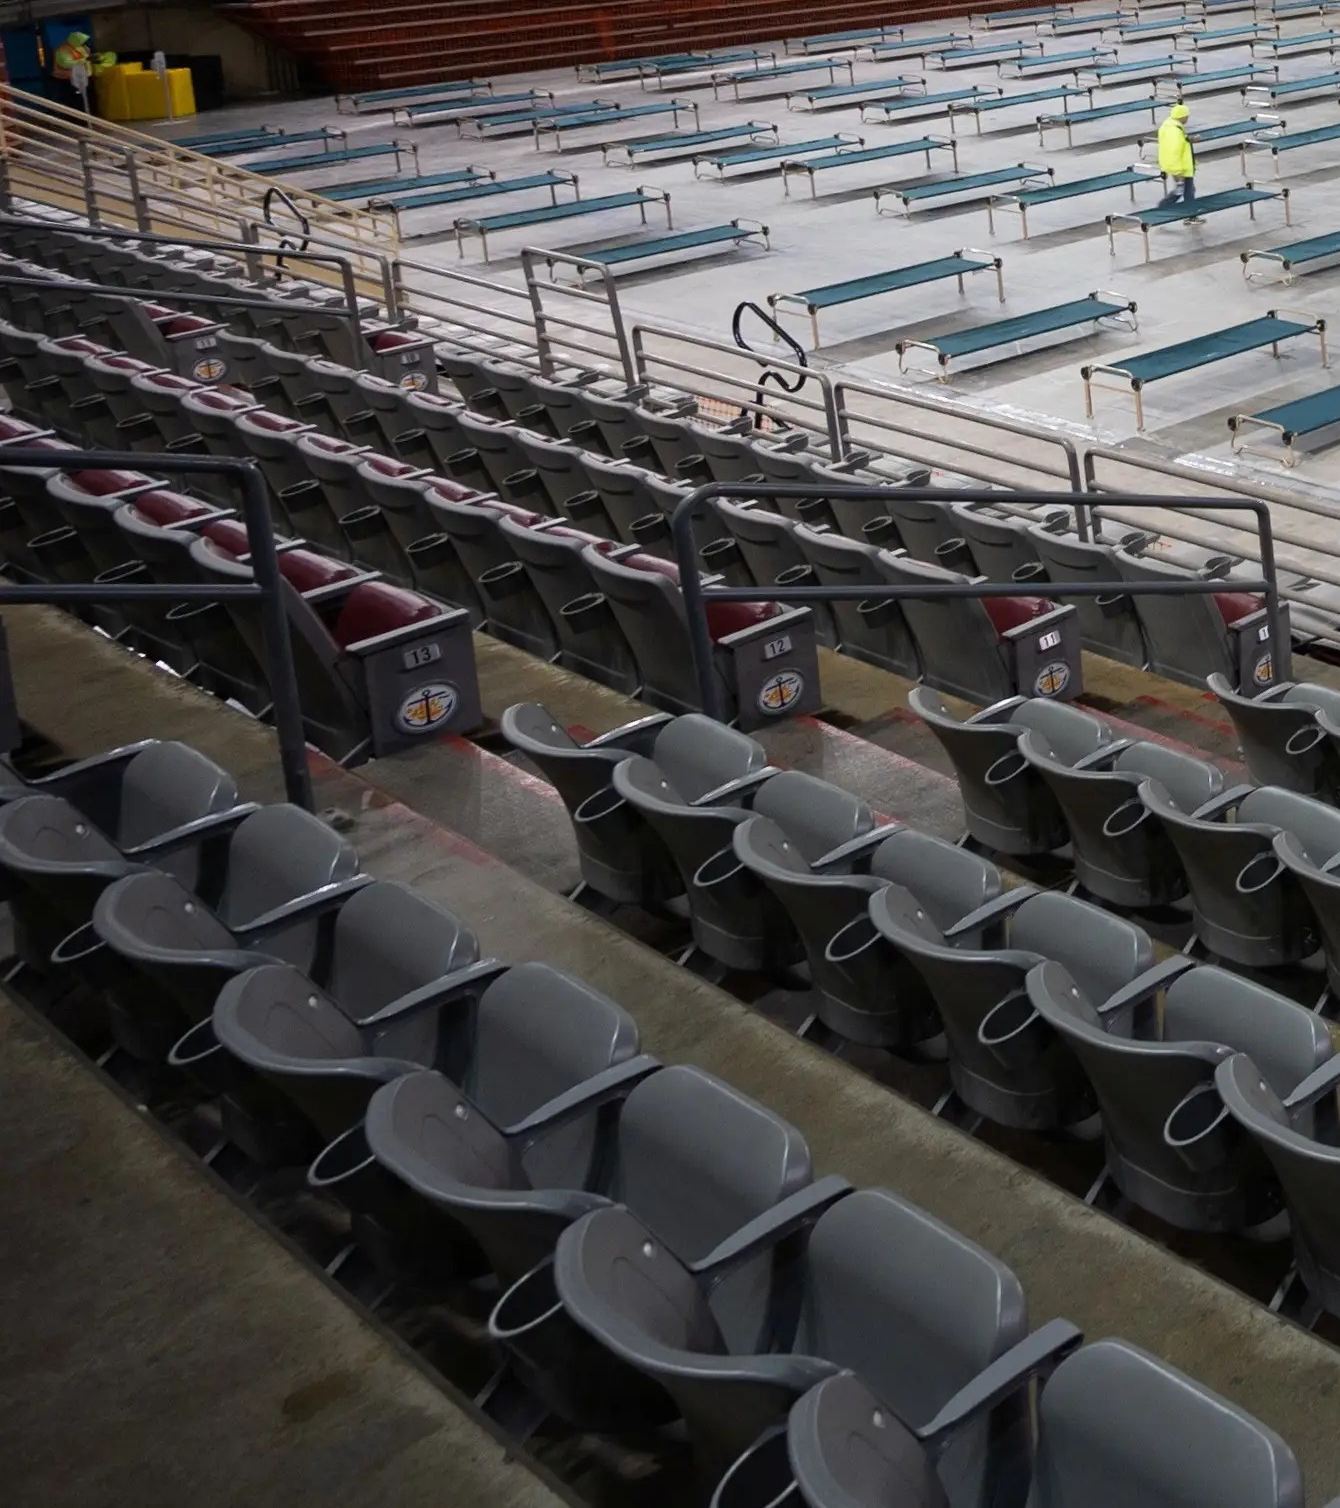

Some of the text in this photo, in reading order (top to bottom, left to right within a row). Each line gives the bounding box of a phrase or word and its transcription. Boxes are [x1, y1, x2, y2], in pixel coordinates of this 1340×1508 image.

[770, 639, 785, 654] 12
[1044, 634, 1056, 647] 11
[412, 647, 431, 664] 13
